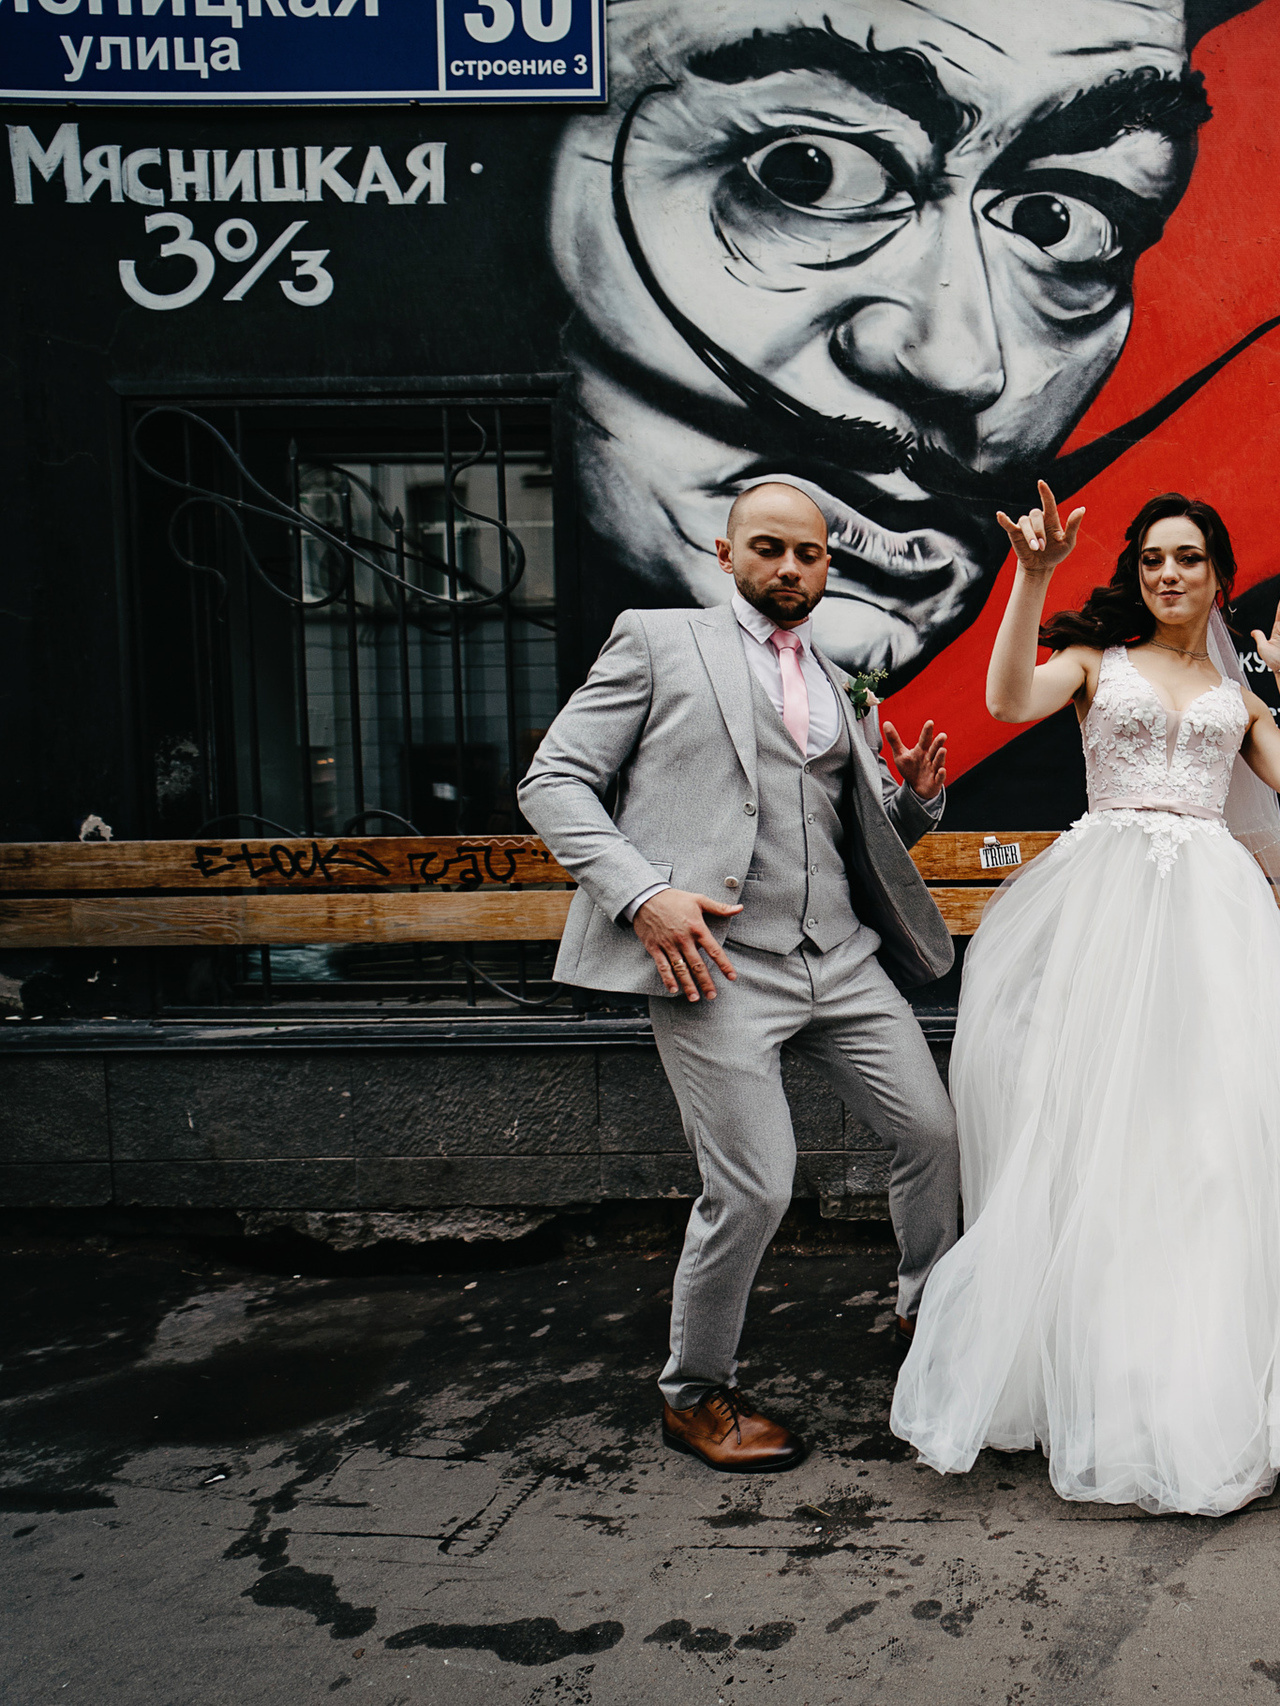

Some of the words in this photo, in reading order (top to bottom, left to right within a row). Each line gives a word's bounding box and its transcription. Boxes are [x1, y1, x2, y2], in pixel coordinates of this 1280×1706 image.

[60, 35, 241, 81] улица
[450, 59, 567, 81] строение
[573, 54, 588, 75] 3
